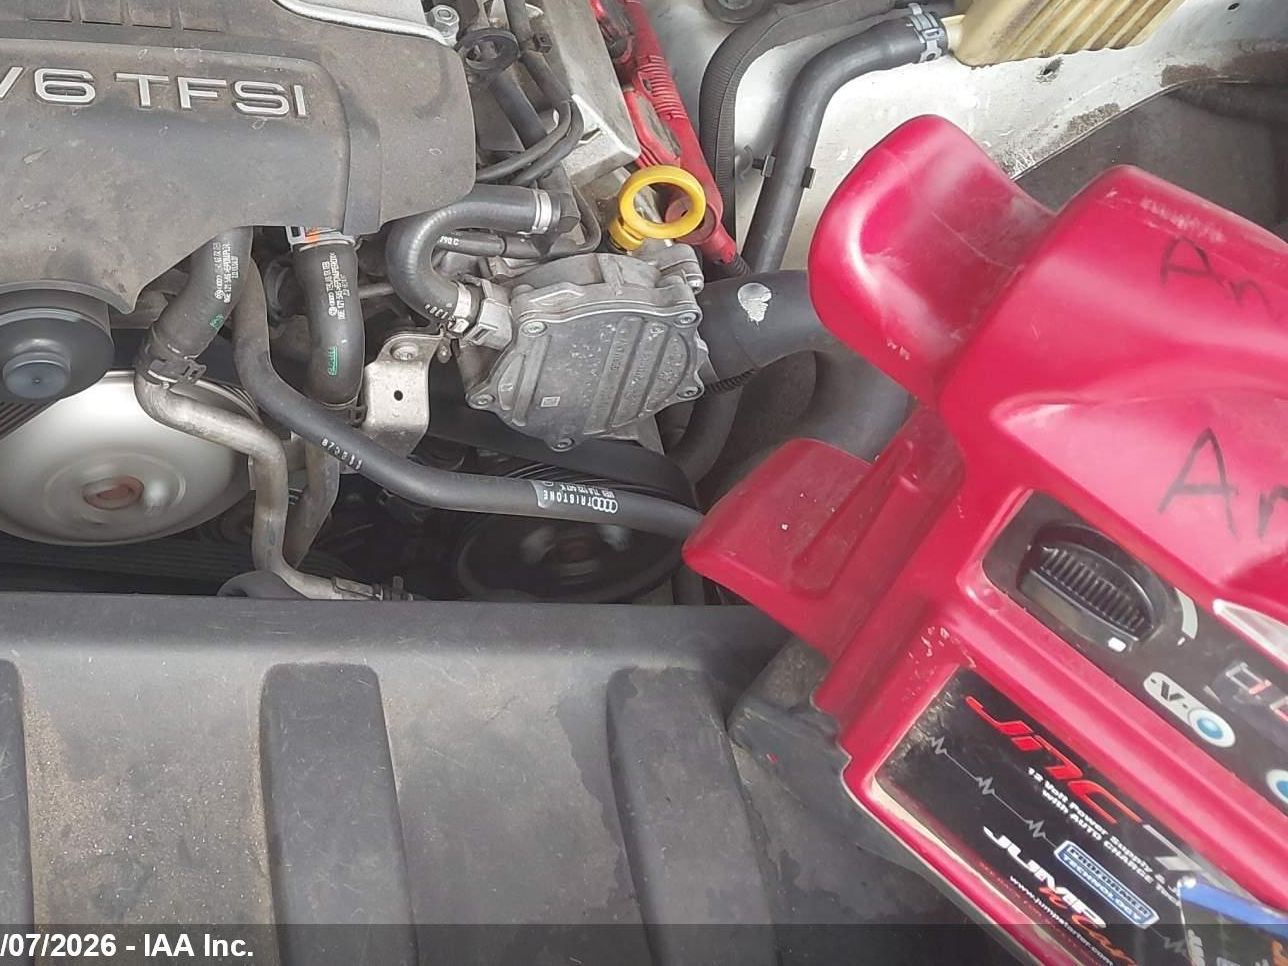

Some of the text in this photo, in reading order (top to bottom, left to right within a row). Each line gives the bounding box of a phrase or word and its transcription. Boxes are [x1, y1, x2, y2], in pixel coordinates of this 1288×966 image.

[114, 72, 308, 118] TFSI
[1028, 766, 1044, 783] 12
[1044, 780, 1069, 803] Volt
[1069, 801, 1109, 836] Power
[1110, 835, 1153, 873] Supply
[1042, 789, 1069, 815] with
[1069, 812, 1103, 841] AUTO
[1103, 840, 1154, 884] CHARGE
[983, 826, 1107, 929] JUMP
[1062, 853, 1142, 921] TECHNOLOGY
[1068, 846, 1150, 916] PROFORMER
